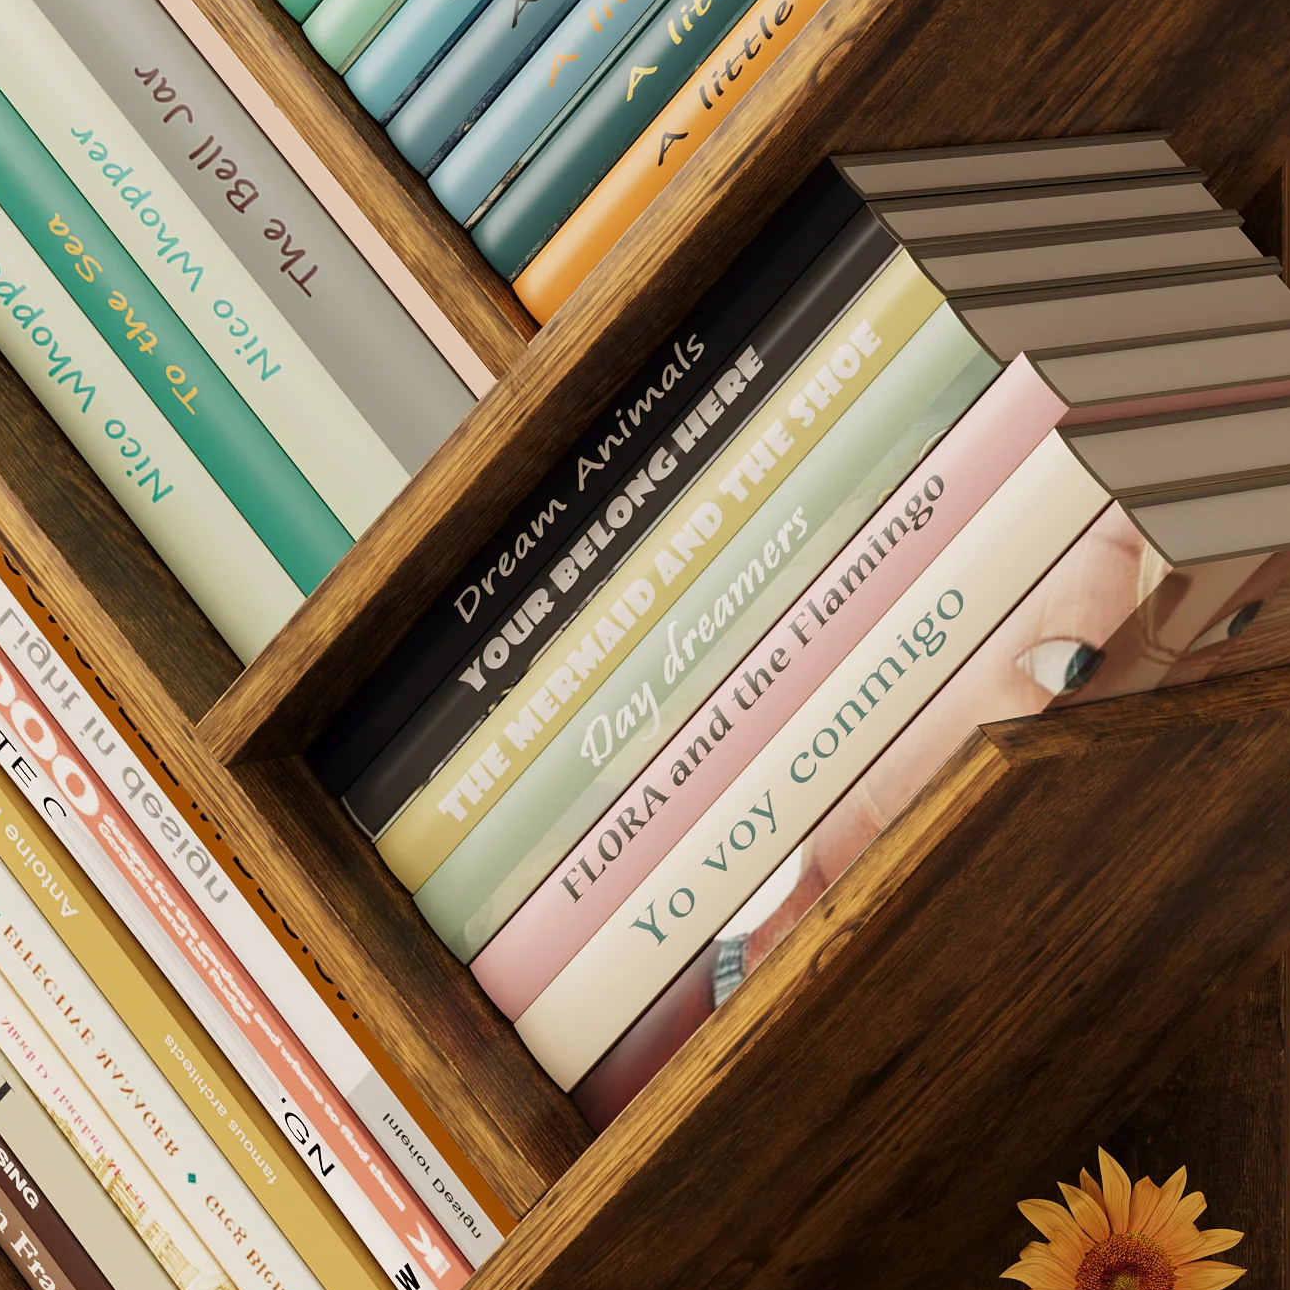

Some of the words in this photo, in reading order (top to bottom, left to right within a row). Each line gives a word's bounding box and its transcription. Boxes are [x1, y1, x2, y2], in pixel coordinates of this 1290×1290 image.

[133, 67, 193, 123] Jar
[620, 59, 658, 102] A
[651, 124, 689, 167] A
[699, 1, 793, 109] little
[67, 122, 204, 293] Whopper
[188, 135, 259, 214] Bell
[44, 209, 106, 283] Sea
[262, 218, 318, 298] The
[102, 286, 163, 357] the
[212, 299, 281, 381] Nico
[156, 364, 199, 418] To
[104, 419, 174, 503] Nico
[453, 493, 569, 623] Dream
[570, 333, 709, 493] Animals
[455, 582, 560, 698] YOUR
[543, 441, 683, 596] BELONG
[667, 341, 771, 456] HERE
[433, 747, 514, 828] THE
[498, 570, 664, 754] MERMAID
[644, 492, 733, 588] AND
[715, 416, 800, 508] THE
[782, 313, 891, 432] SHOE
[578, 678, 670, 771] Day
[652, 503, 816, 687] dreamers
[560, 784, 670, 902] FLORA
[669, 704, 739, 791] and
[733, 647, 796, 715] the
[788, 475, 944, 647] Flamingo
[630, 887, 695, 946] Yo
[701, 789, 777, 871] voy
[789, 588, 964, 783] conmigo
[0, 819, 80, 922] Antoine
[160, 1030, 230, 1120] architects
[225, 1116, 281, 1187] famous
